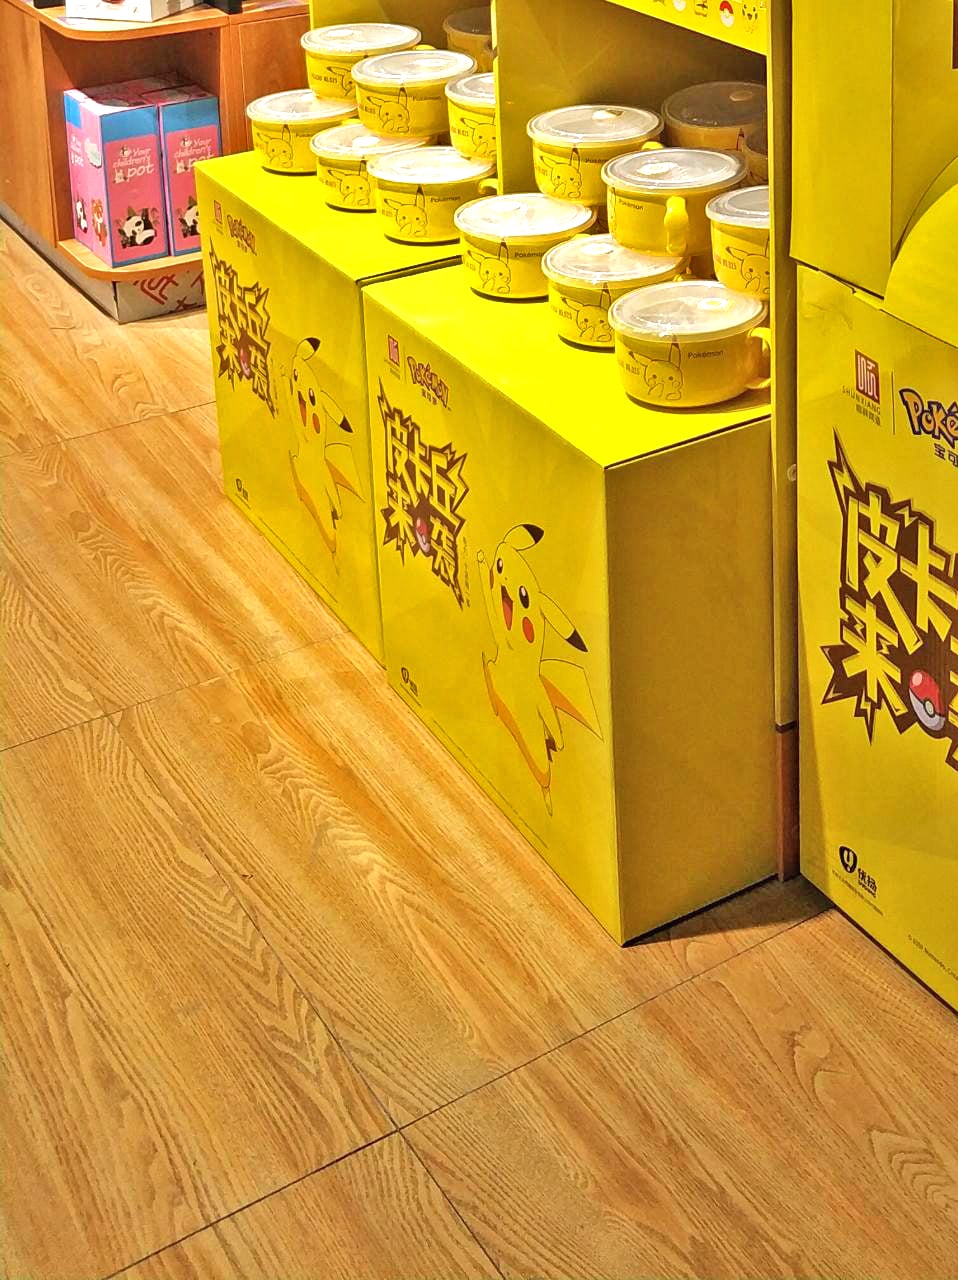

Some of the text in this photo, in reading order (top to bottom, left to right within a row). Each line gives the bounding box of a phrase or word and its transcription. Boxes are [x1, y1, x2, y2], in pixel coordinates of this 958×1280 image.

[127, 165, 155, 182] pot
[216, 260, 270, 351] 皮卡丘
[385, 410, 465, 531] 皮卡丘
